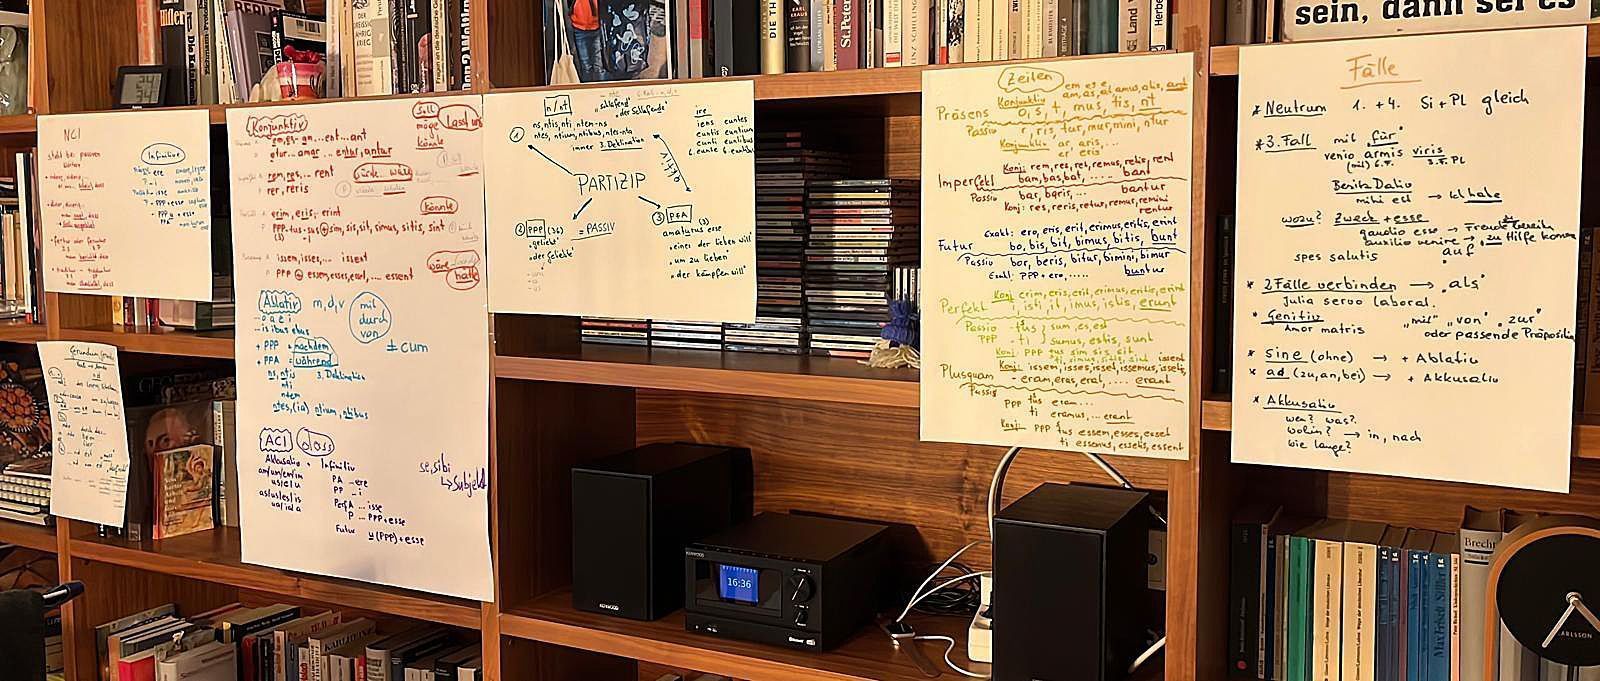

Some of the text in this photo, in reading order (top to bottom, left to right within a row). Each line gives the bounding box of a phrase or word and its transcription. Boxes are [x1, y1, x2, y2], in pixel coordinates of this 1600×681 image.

[1295, 0, 1368, 24] sein,
[1382, 0, 1463, 19] dann
[1129, 8, 1138, 35] Land
[1346, 54, 1400, 79] Fälle
[1008, 71, 1053, 85] Zeiten
[1265, 100, 1327, 115] Neutrum
[1482, 89, 1529, 115] gleich
[937, 106, 989, 120] Präsens
[1364, 148, 1403, 159] armis
[1413, 145, 1443, 155] viris
[578, 173, 646, 195] PARTIZIP
[938, 174, 995, 190] Imperfekt
[1121, 183, 1167, 194] bantur
[587, 222, 616, 235] PASSIV
[1507, 232, 1536, 245] Hilfe
[938, 240, 973, 251] Futur
[1294, 251, 1378, 263] spes salutis
[1318, 278, 1397, 291] verbinden
[940, 298, 989, 314] Perfekt
[1283, 296, 1363, 307] Julia servo
[359, 313, 388, 325] durch
[1268, 311, 1321, 322] Genitiv
[1285, 324, 1519, 340] Amor matris oder passende
[400, 342, 428, 353] cum
[1265, 348, 1479, 365] sine (ohne) Ablativ
[1266, 367, 1499, 384] ad Akkusativ
[1268, 395, 1336, 409] Akkusativ
[1393, 430, 1422, 442] nach
[1288, 439, 1308, 449] wie
[1465, 538, 1496, 549] Brecht
[728, 578, 751, 589] 16:36
[1558, 630, 1592, 639] ARLSSON
